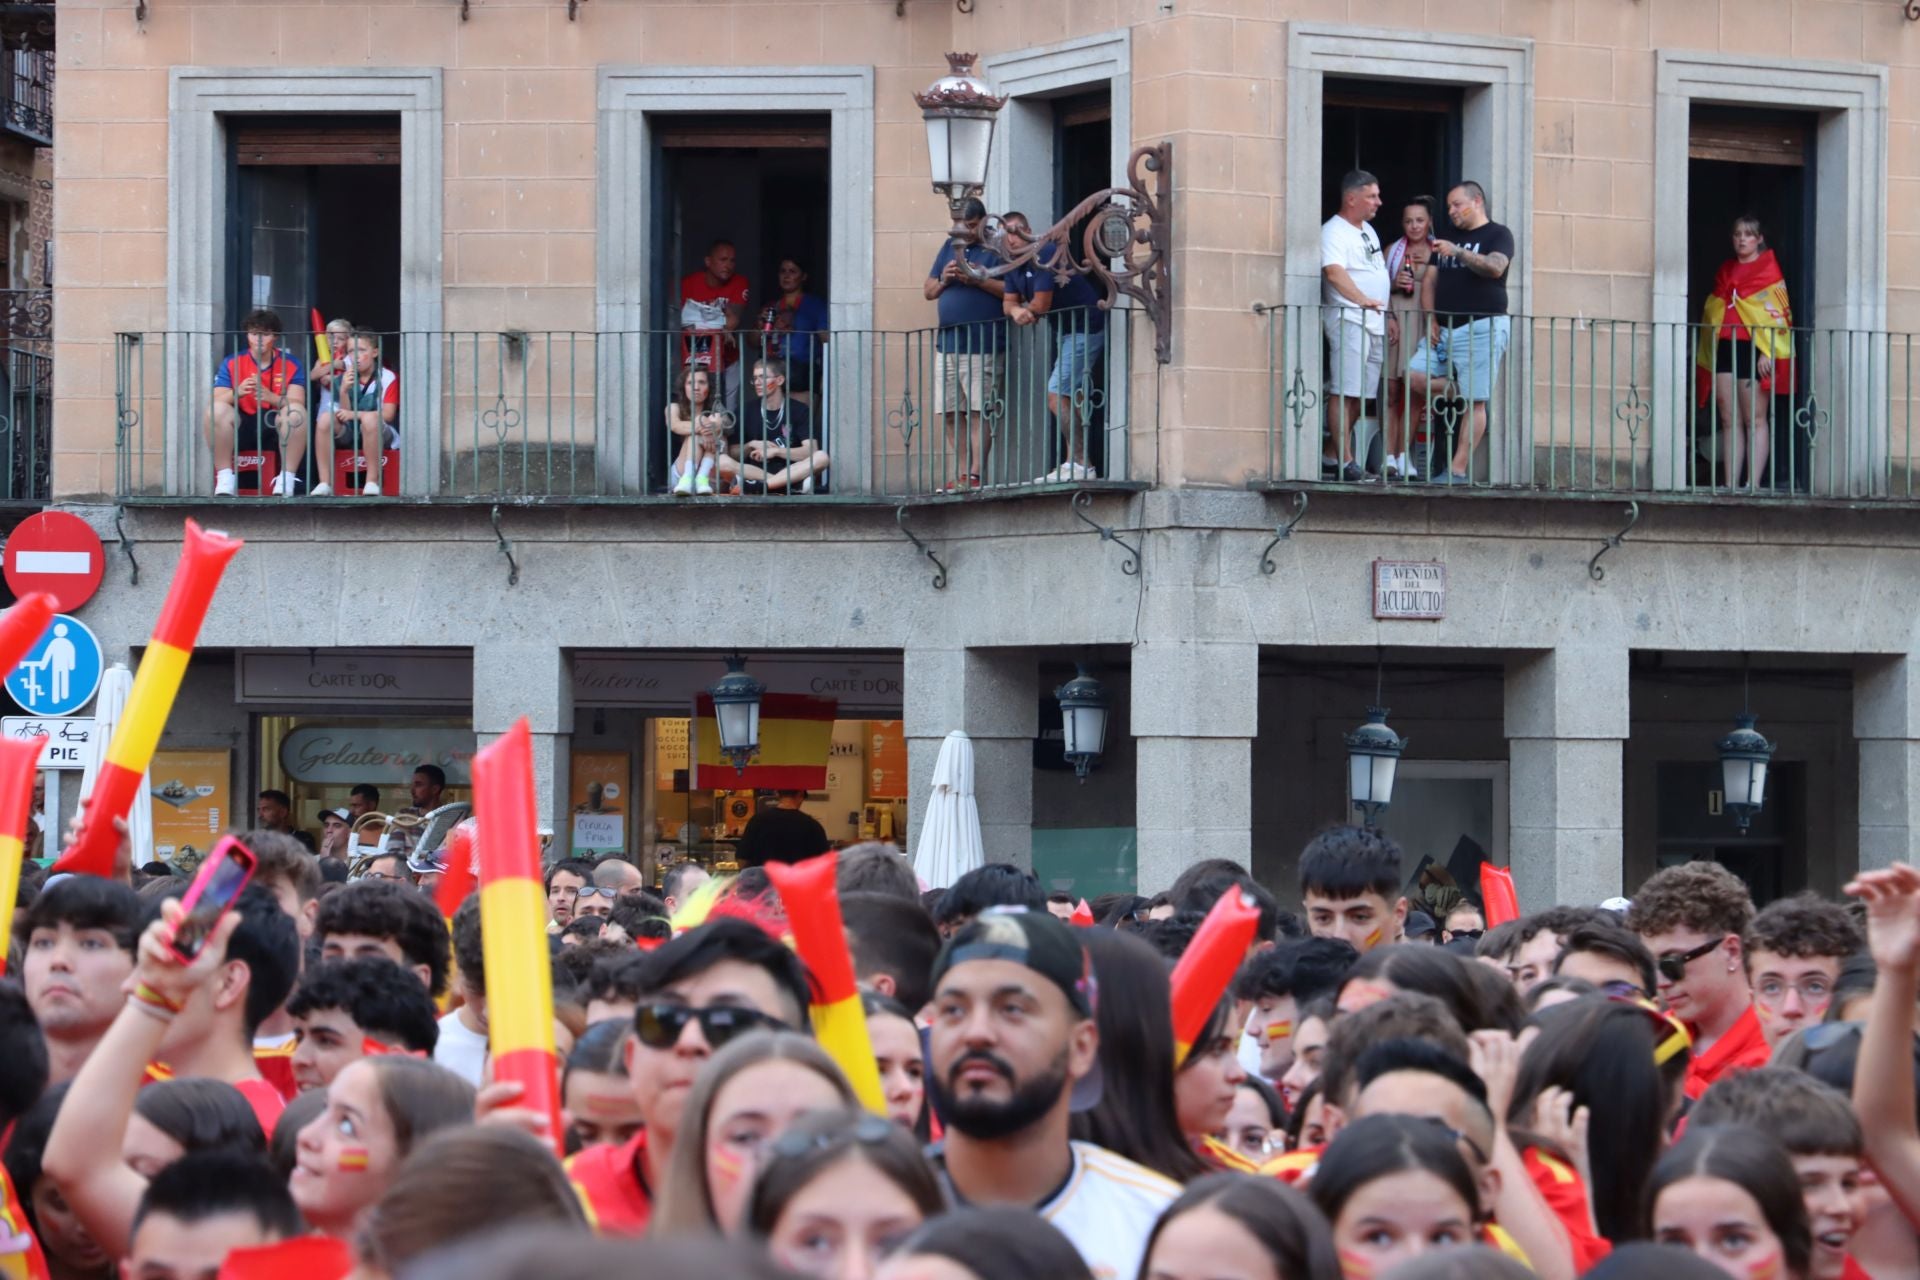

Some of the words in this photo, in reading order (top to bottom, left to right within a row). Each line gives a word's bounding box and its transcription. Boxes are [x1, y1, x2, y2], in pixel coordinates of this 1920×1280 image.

[1392, 567, 1439, 580] AVENIDA
[1381, 590, 1440, 611] ACUEDUCTO
[574, 665, 661, 688] elateria
[50, 747, 79, 760] PIE
[299, 736, 422, 774] Gelateria
[1711, 791, 1719, 812] 1
